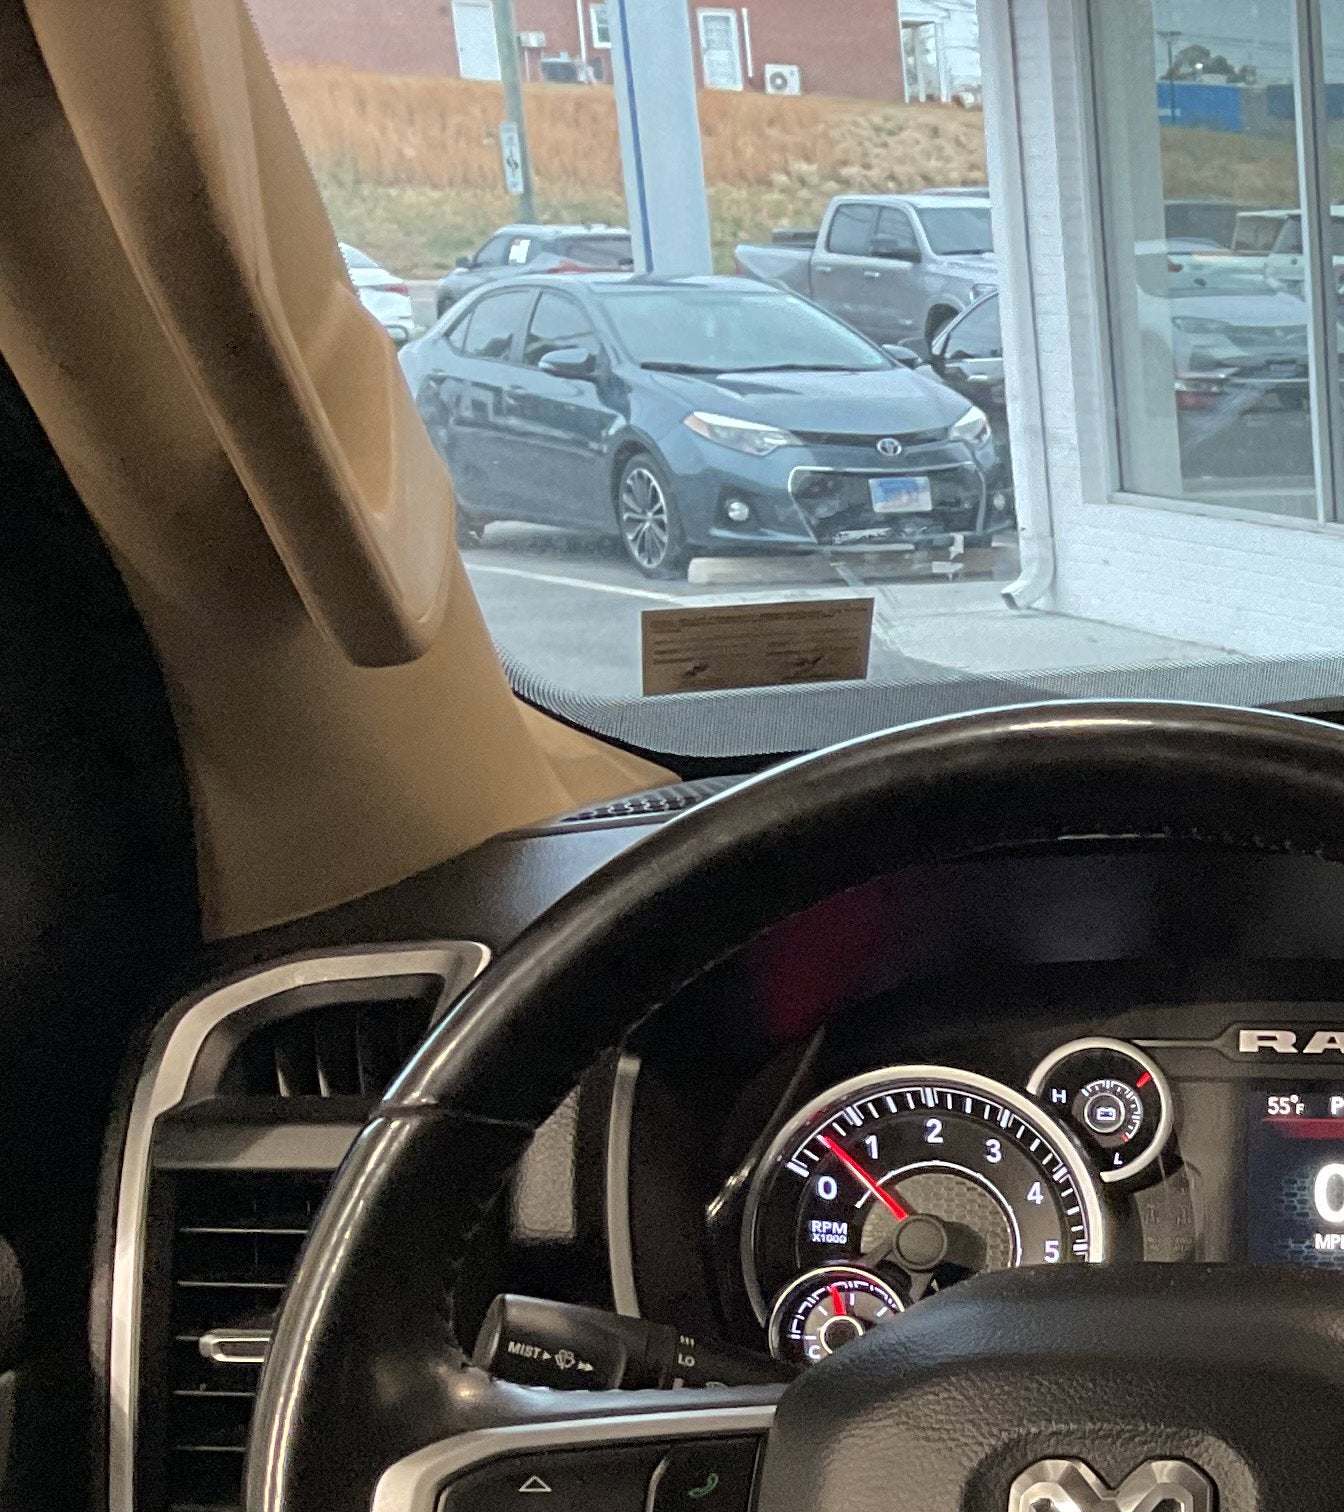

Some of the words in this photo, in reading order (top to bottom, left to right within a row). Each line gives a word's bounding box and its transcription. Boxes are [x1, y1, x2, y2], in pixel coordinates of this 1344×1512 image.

[1051, 1089, 1067, 1104] H
[1267, 1095, 1305, 1117] 55°F
[1331, 1097, 1344, 1117] P
[926, 1118, 944, 1144] 2
[865, 1135, 880, 1161] 1
[985, 1138, 1002, 1164] 3
[1113, 1152, 1124, 1167] L
[816, 1176, 838, 1201] 0
[1027, 1182, 1045, 1206] 4
[811, 1219, 848, 1235] RPM
[1044, 1240, 1061, 1263] 5
[507, 1340, 543, 1361] MIST
[677, 1351, 695, 1368] LO
[808, 1345, 822, 1361] C
